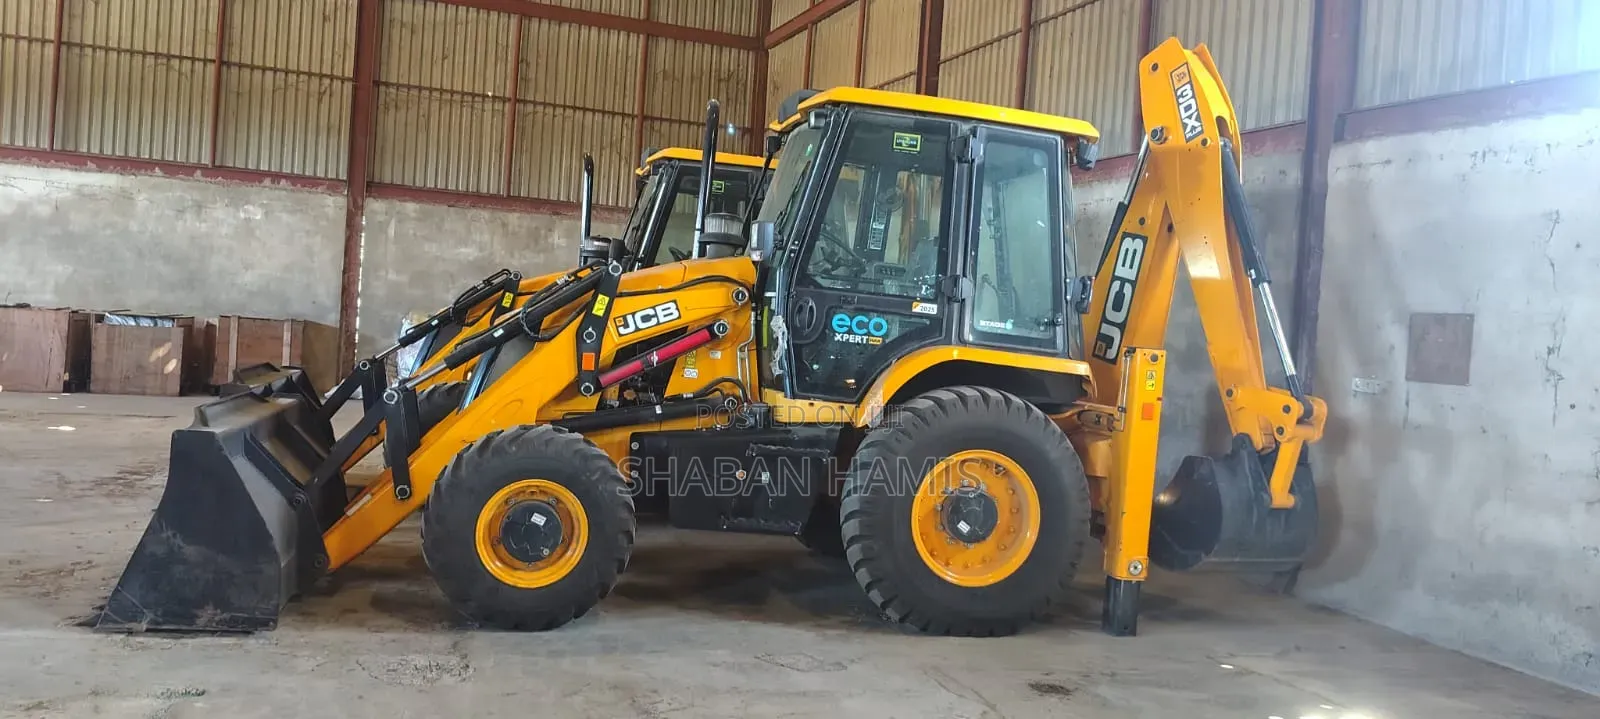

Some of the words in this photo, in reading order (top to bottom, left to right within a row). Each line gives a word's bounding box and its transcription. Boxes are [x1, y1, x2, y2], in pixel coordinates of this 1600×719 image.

[1176, 83, 1202, 134] 3DX
[1099, 237, 1144, 359] JCB
[617, 301, 680, 335] JCB
[831, 313, 888, 337] eco
[834, 332, 869, 344] XPERT
